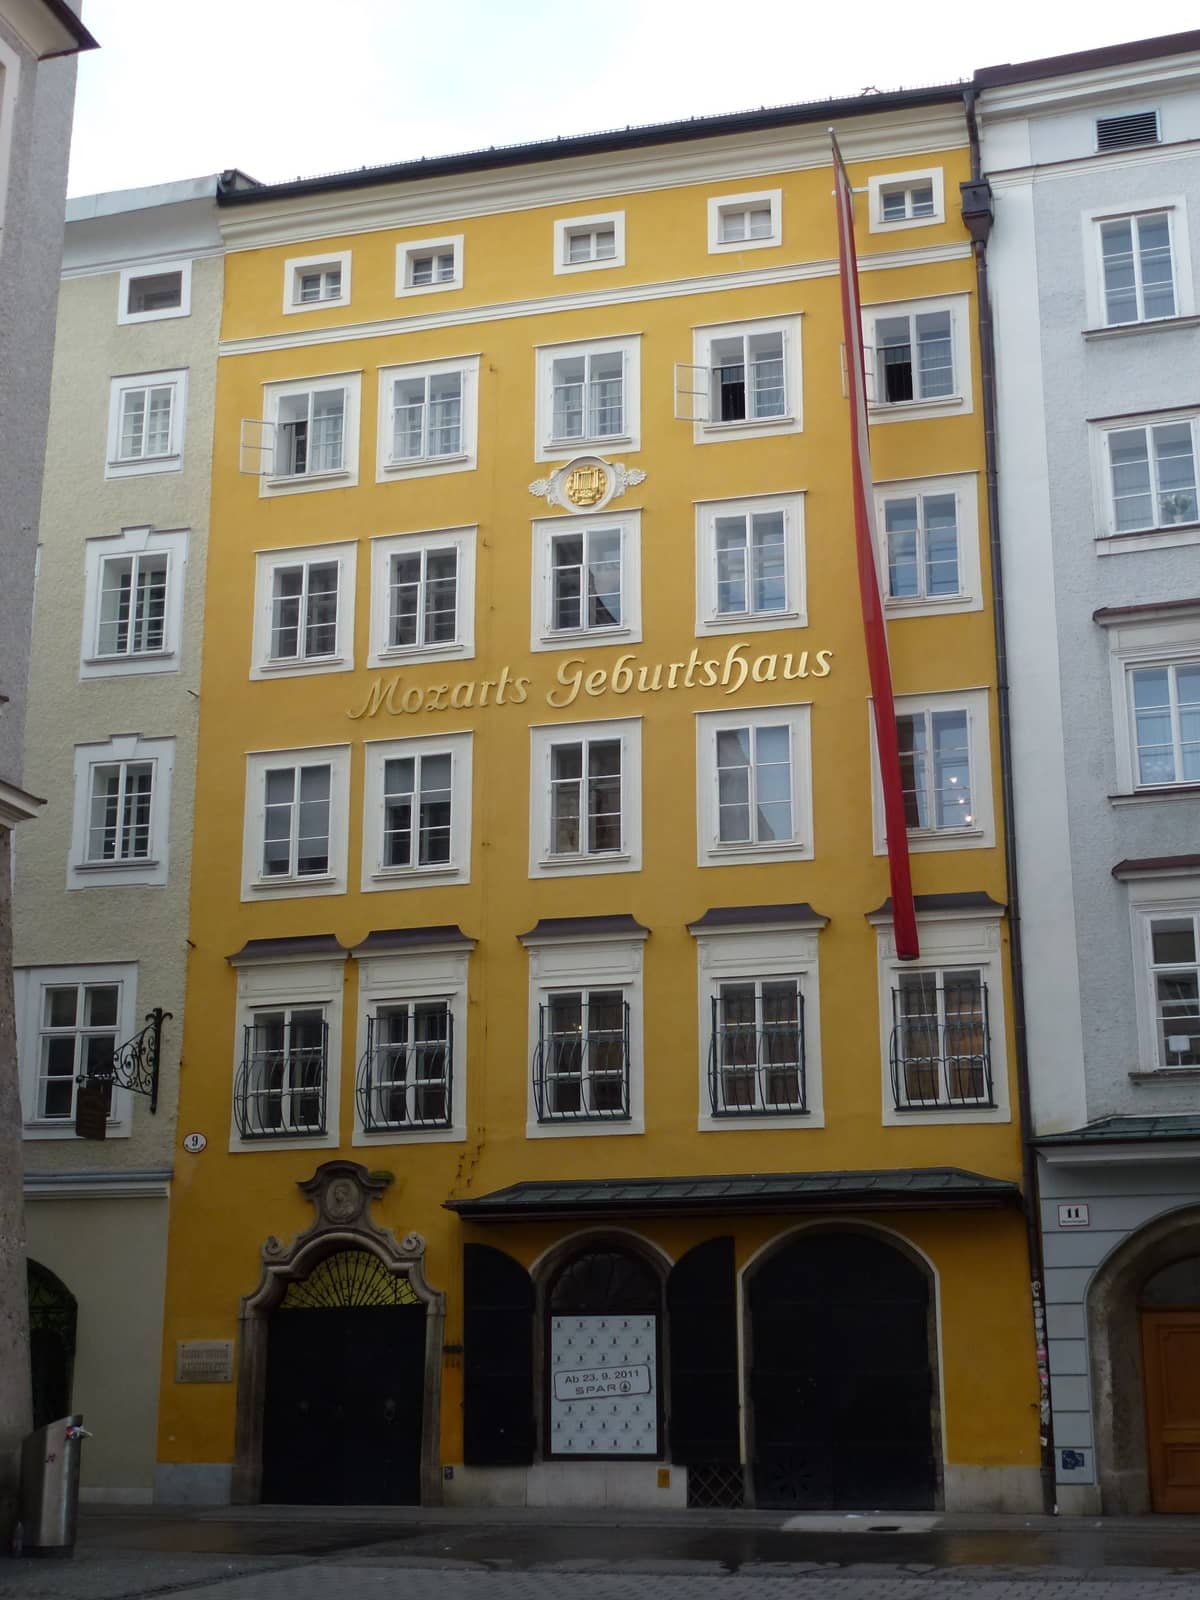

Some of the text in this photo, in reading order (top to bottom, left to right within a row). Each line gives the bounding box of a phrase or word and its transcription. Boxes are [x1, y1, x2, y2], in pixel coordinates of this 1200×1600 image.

[346, 642, 833, 719] Mozarts Geburtshaus
[192, 1135, 199, 1147] 9
[1067, 1207, 1079, 1218] 11
[565, 1375, 579, 1385] Ab
[614, 1370, 639, 1380] 2011
[575, 1384, 617, 1395] SPAR
